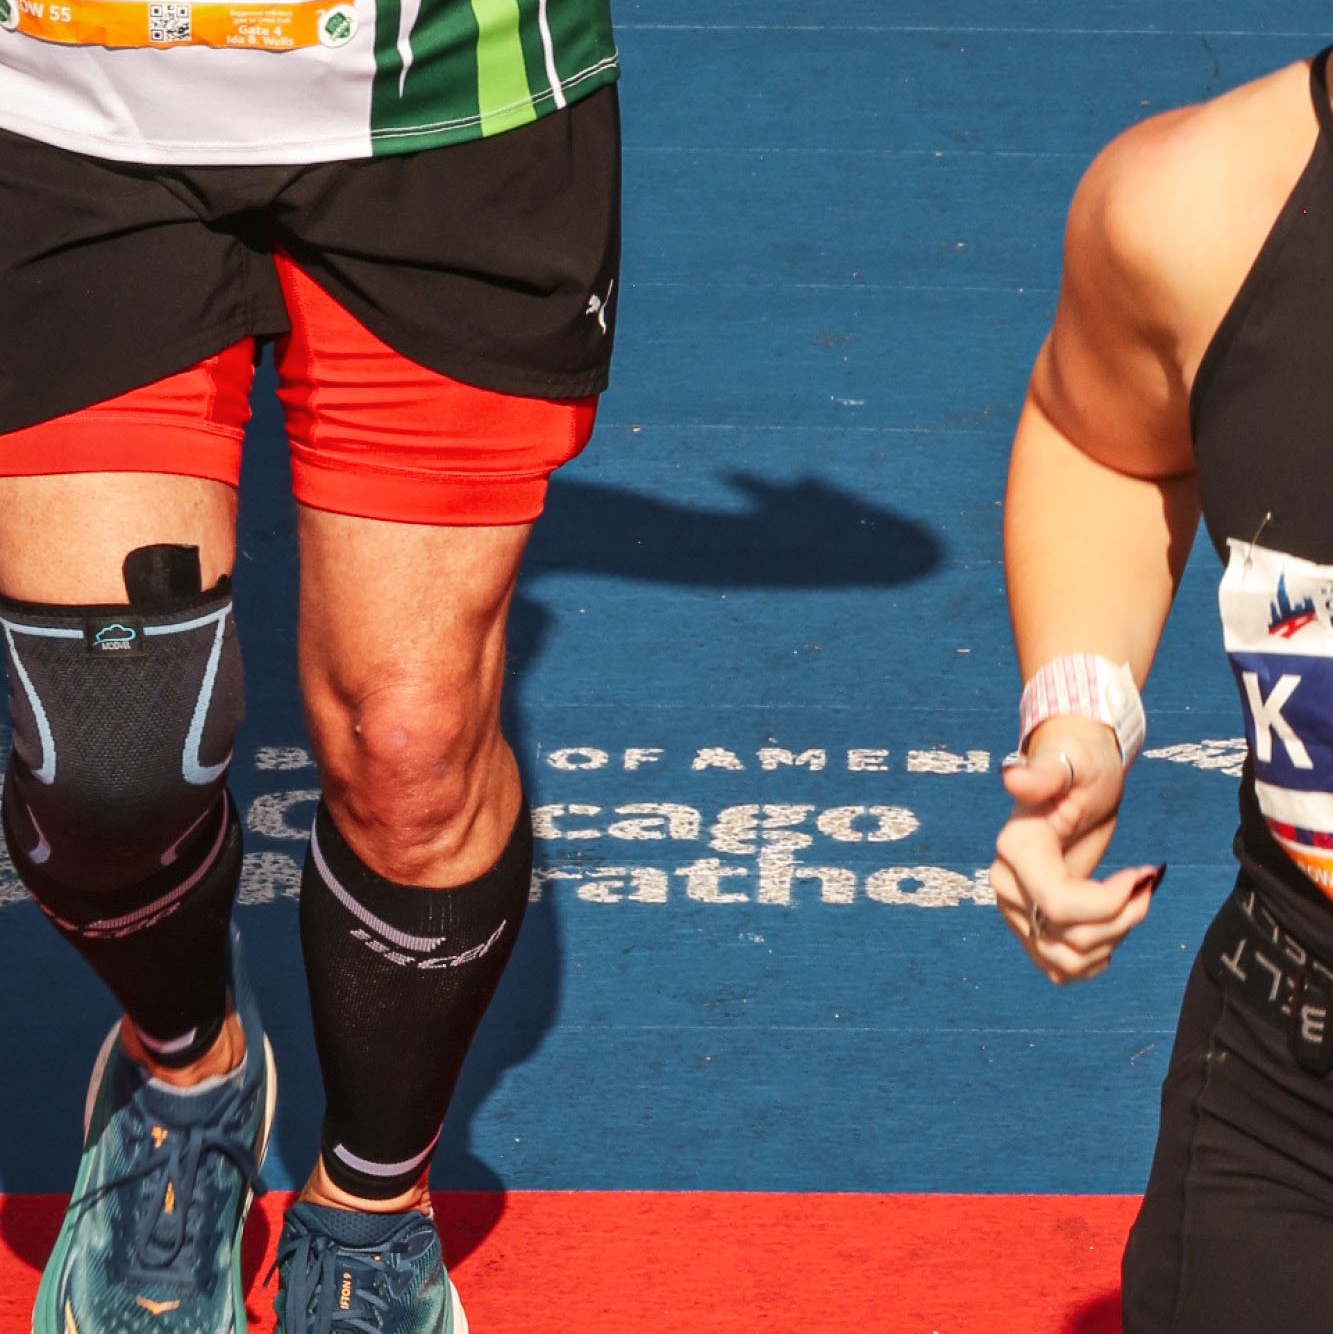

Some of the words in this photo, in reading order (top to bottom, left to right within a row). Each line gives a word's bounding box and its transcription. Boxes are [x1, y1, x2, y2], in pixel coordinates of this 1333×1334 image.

[49, 3, 73, 23] 55
[238, 24, 270, 37] Gate
[1243, 671, 1314, 770] K
[547, 746, 665, 771] OF
[246, 789, 921, 854] Ccago
